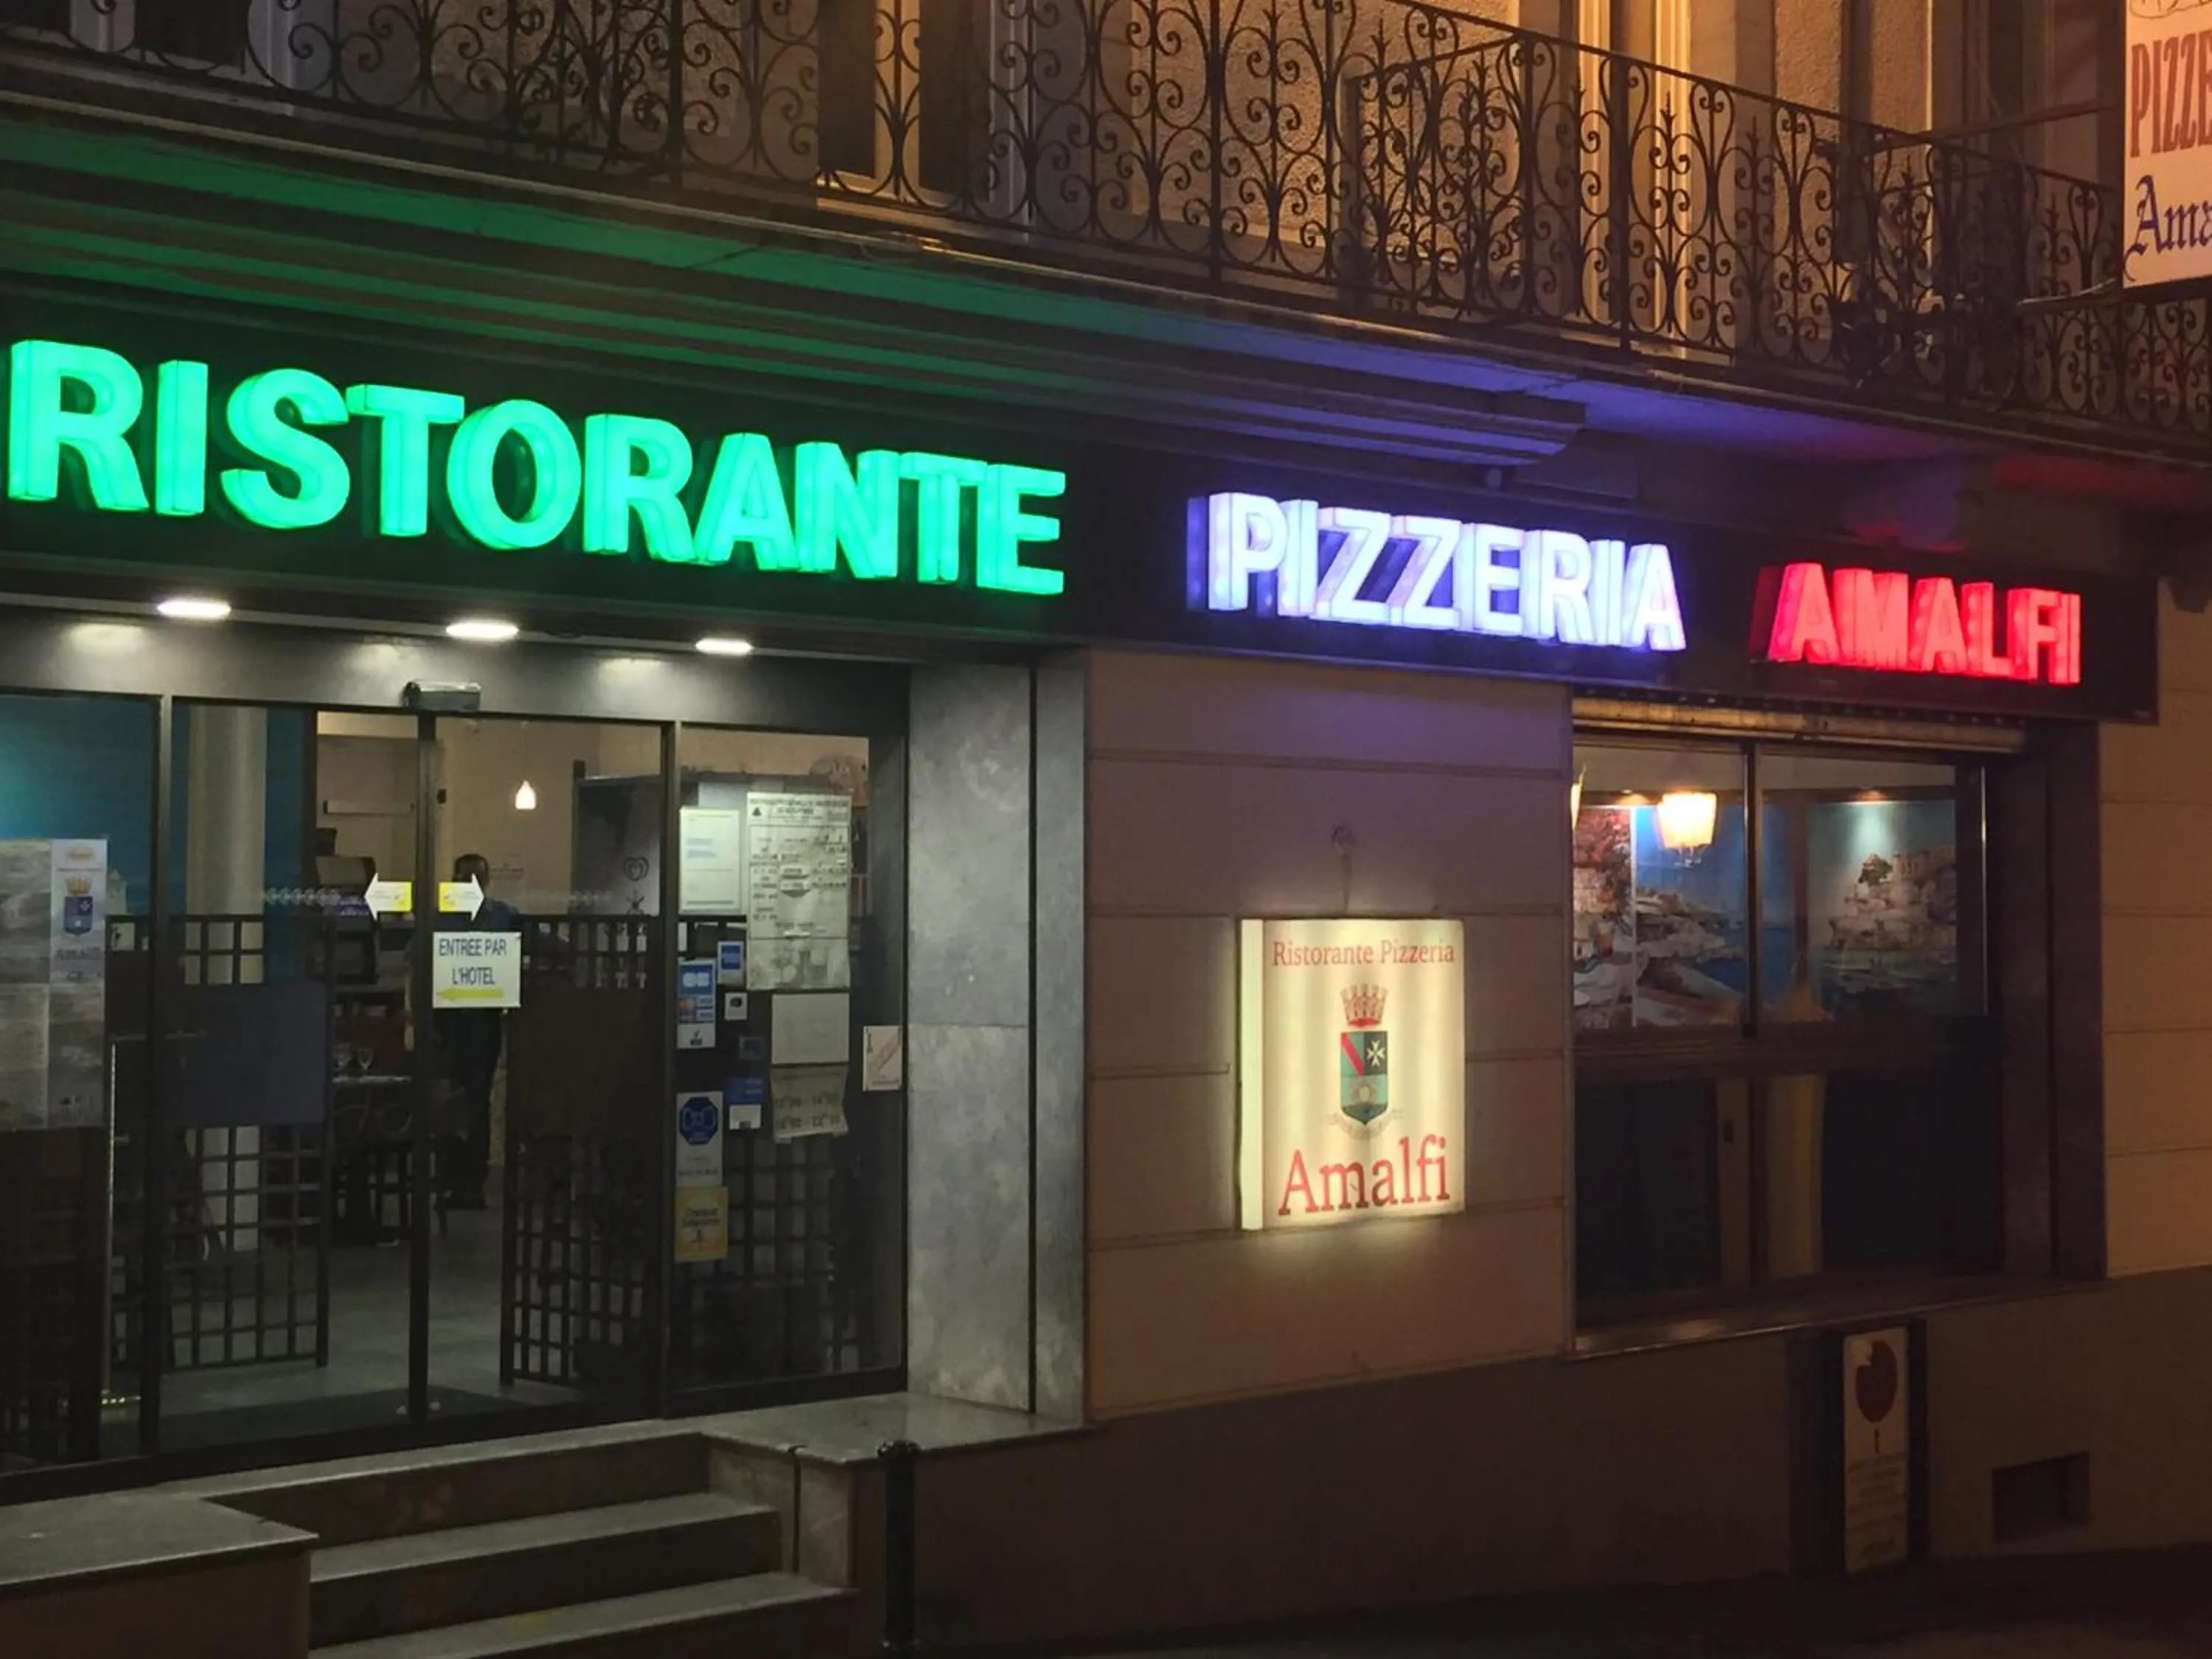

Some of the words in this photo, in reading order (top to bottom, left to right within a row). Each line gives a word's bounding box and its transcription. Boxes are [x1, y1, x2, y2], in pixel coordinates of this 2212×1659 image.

[7, 339, 1067, 596] RISTORANTE
[1208, 492, 1687, 653] PIZZERIA
[1768, 562, 2081, 685] AMALFI
[439, 938, 482, 956] ENTREE
[485, 938, 507, 956] PAR
[1273, 941, 1375, 967] Ristorante
[1380, 939, 1455, 965] Pizzeria
[1278, 1133, 1450, 1217] Amalfi
